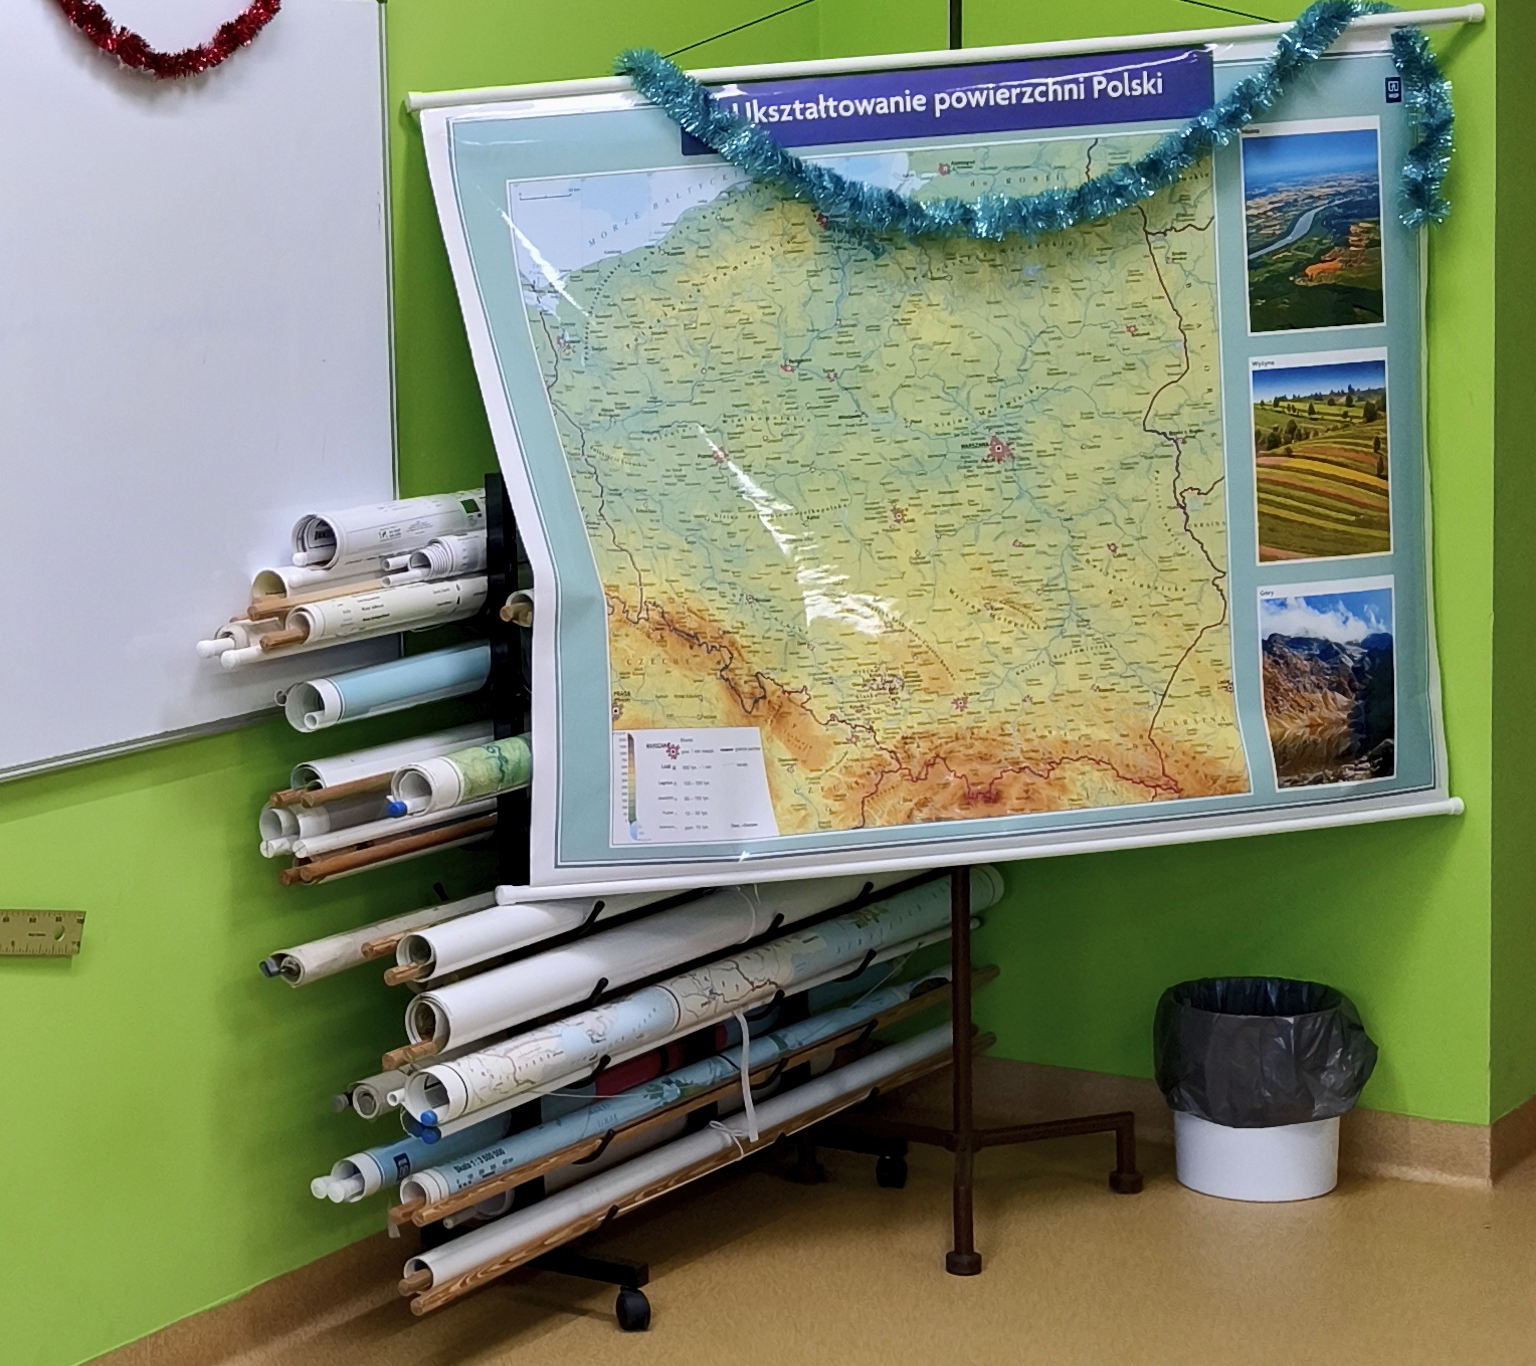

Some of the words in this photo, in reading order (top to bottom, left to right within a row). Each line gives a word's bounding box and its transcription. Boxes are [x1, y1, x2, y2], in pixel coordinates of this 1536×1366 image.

[732, 89, 927, 125] Ukształtowanie
[934, 76, 1086, 118] powierzchni
[1093, 71, 1163, 100] Polski
